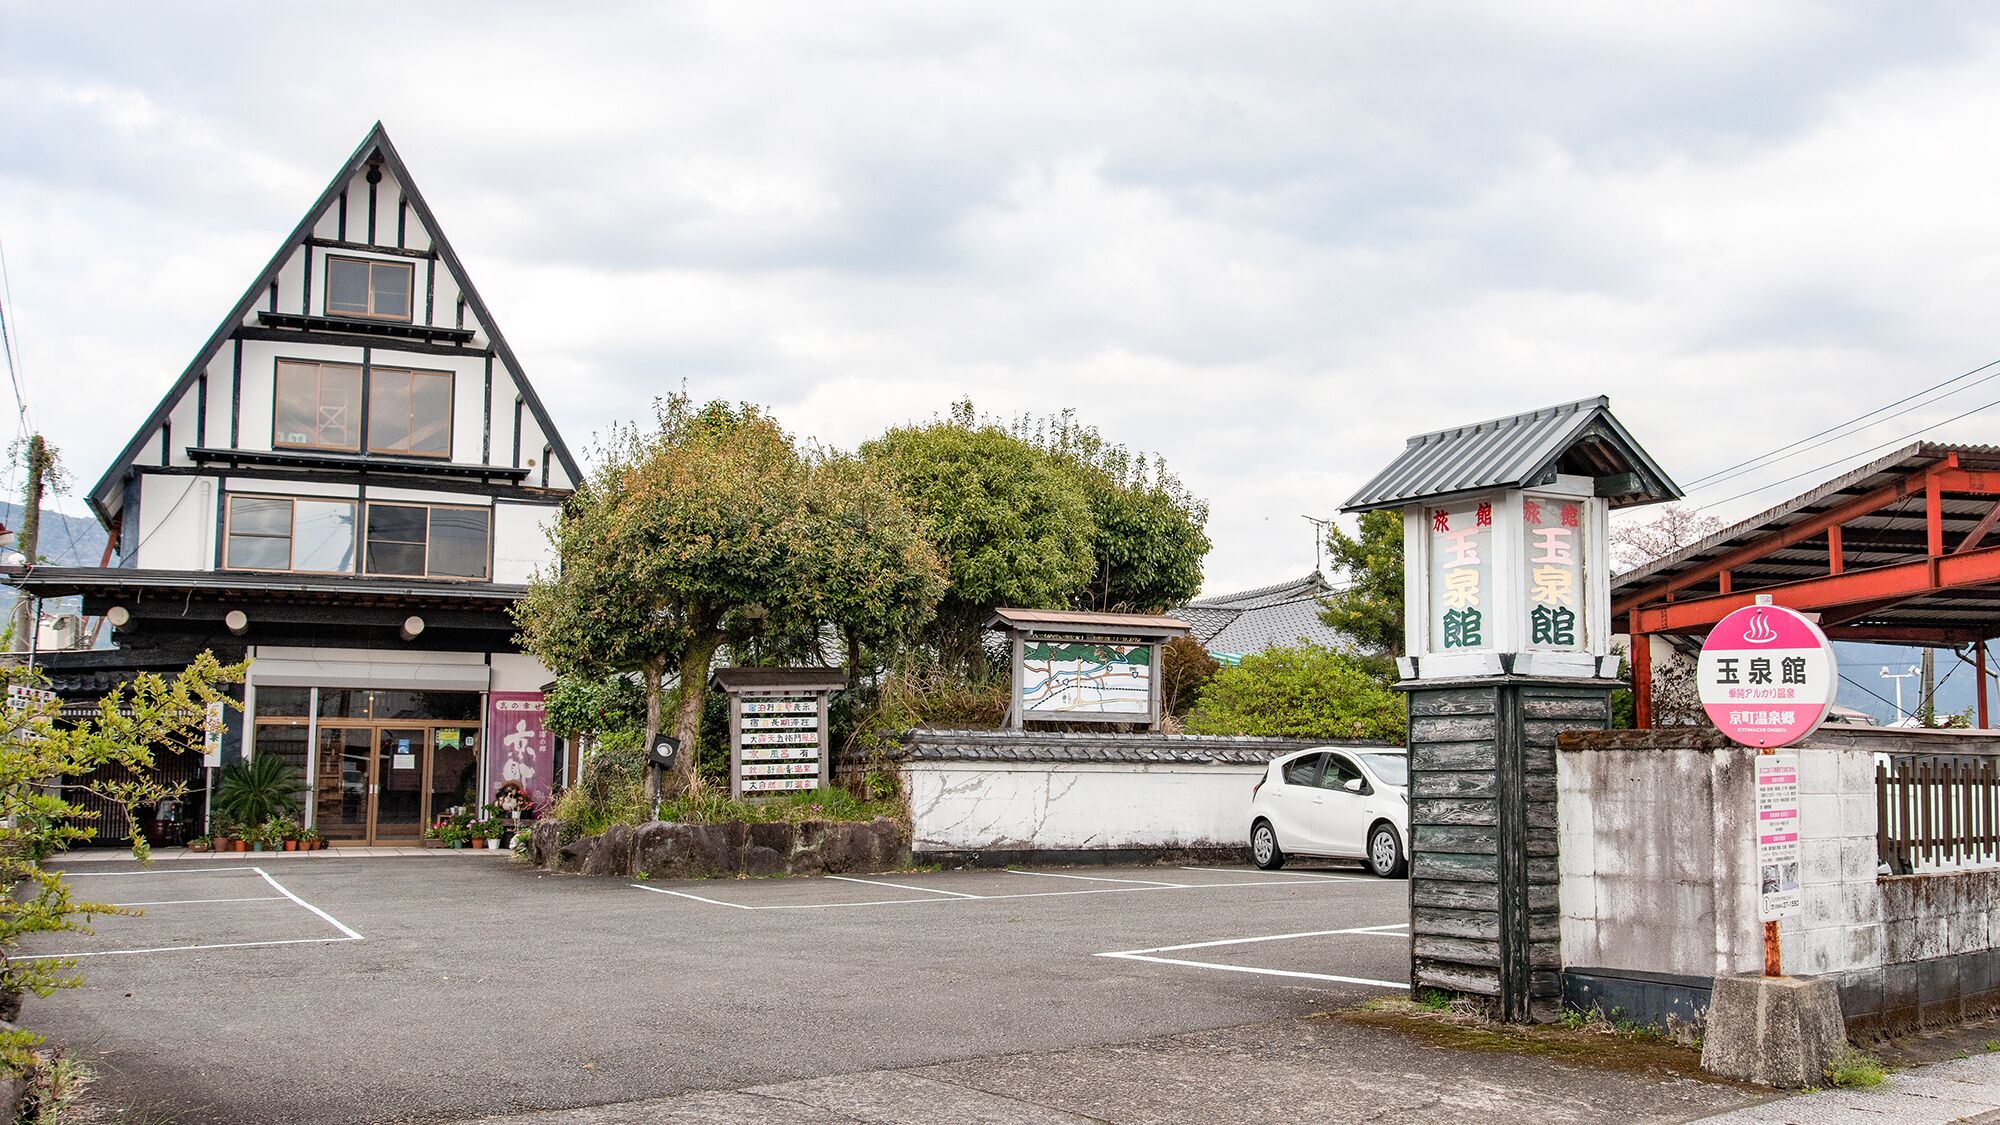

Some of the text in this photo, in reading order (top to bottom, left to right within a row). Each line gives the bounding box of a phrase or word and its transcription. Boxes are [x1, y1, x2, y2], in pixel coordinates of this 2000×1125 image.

[1433, 502, 1492, 533] 旅館
[1523, 500, 1579, 528] 旅館
[1442, 527, 1483, 649] 玉泉館
[1530, 527, 1576, 646] 玉泉館
[1716, 656, 1806, 685] 玉泉館
[1728, 710, 1796, 725] 京町温泉郷
